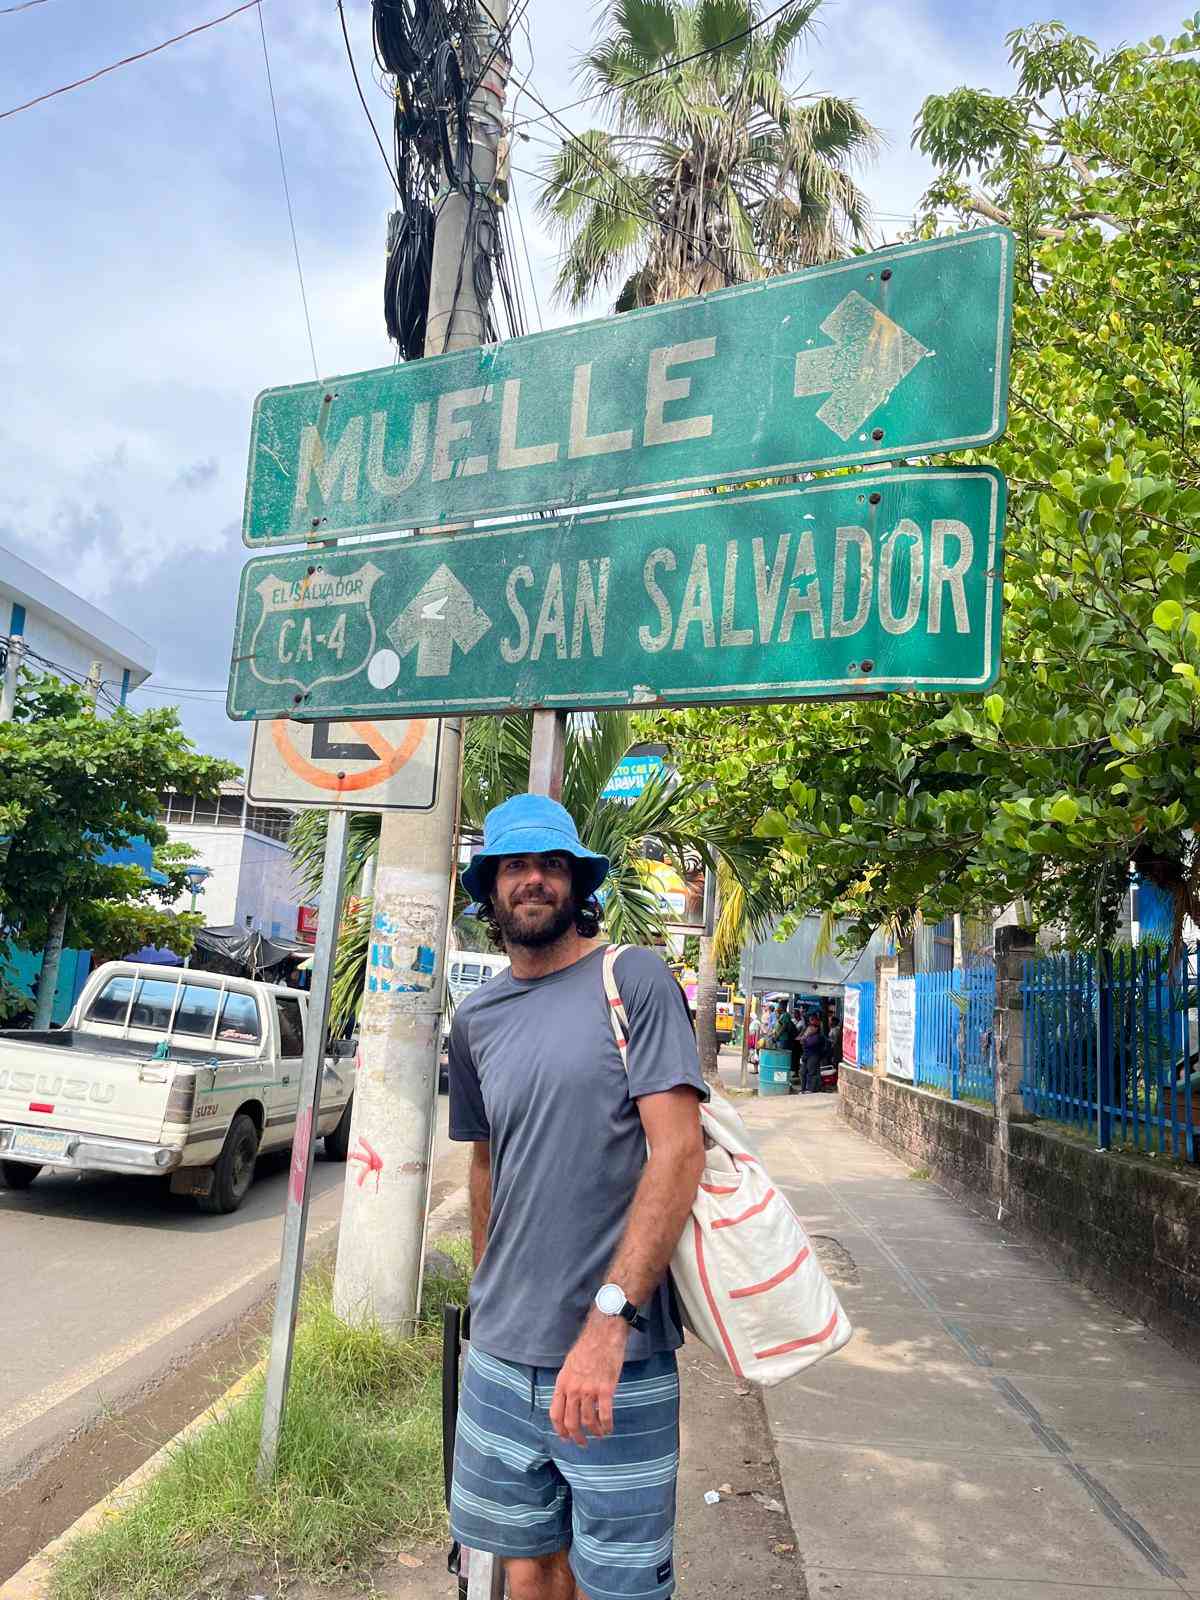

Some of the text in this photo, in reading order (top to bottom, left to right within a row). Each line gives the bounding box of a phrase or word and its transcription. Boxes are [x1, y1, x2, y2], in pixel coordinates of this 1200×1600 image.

[294, 336, 717, 510] MUELLE
[272, 578, 364, 605] EL SALVADOR
[278, 612, 347, 664] CA-4
[500, 518, 974, 663] SAN SALVADOR
